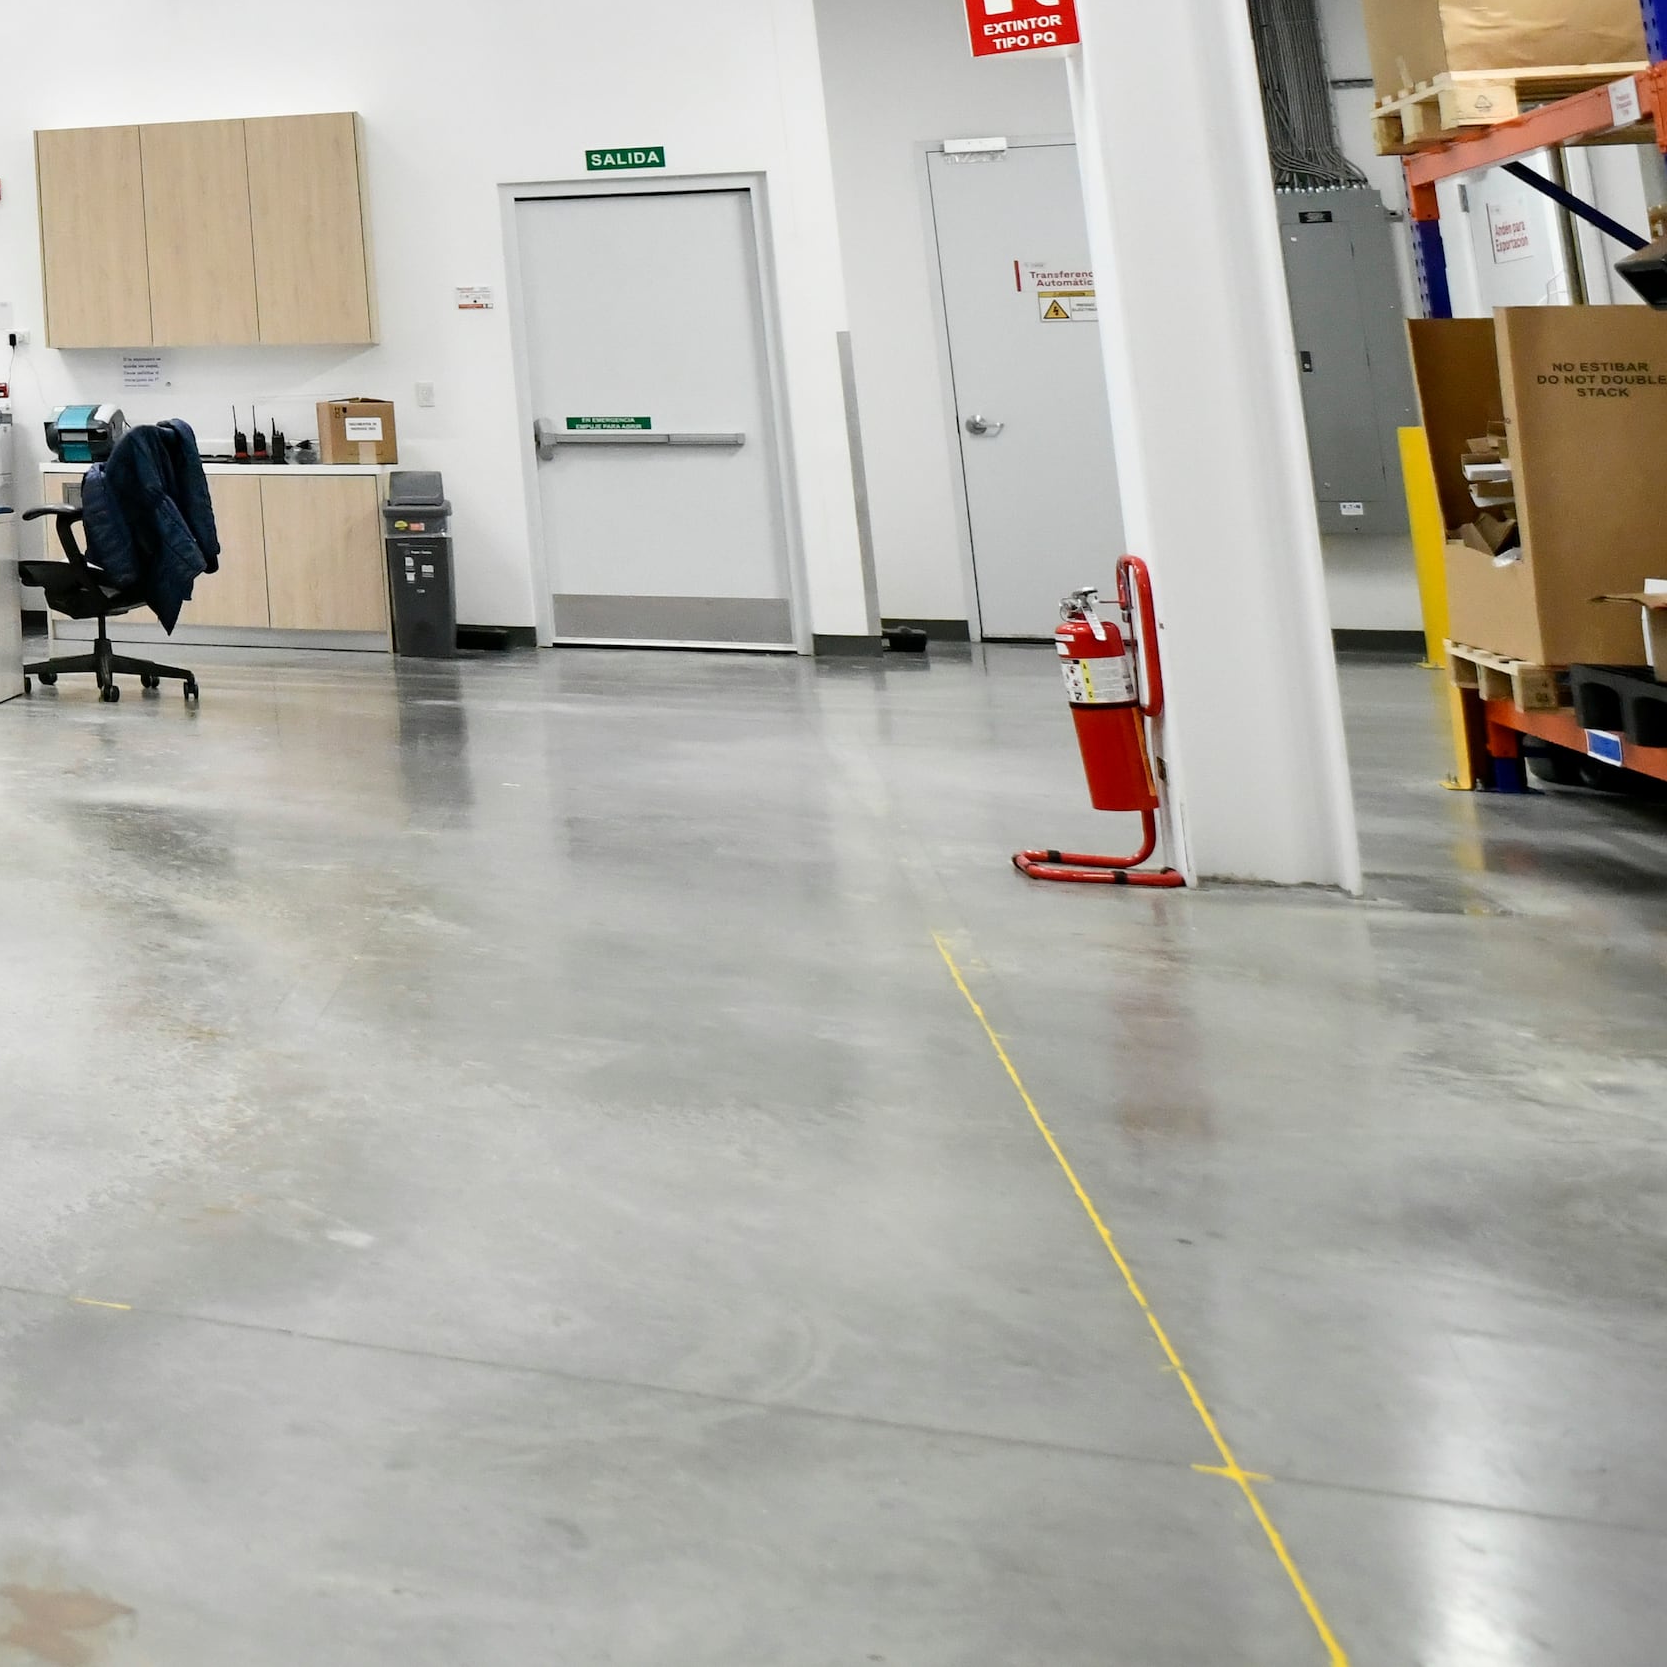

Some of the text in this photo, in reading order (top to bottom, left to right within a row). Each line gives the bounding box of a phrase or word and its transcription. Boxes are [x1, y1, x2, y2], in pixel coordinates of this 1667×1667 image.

[983, 14, 1063, 36] EXTINTOR
[992, 31, 1057, 50] TIPO PQ
[591, 151, 660, 167] SALIDA
[1552, 362, 1649, 372] NO ESTIBAR
[1537, 375, 1667, 385] DO NOT DOUBLE
[1577, 387, 1630, 398] STACK
